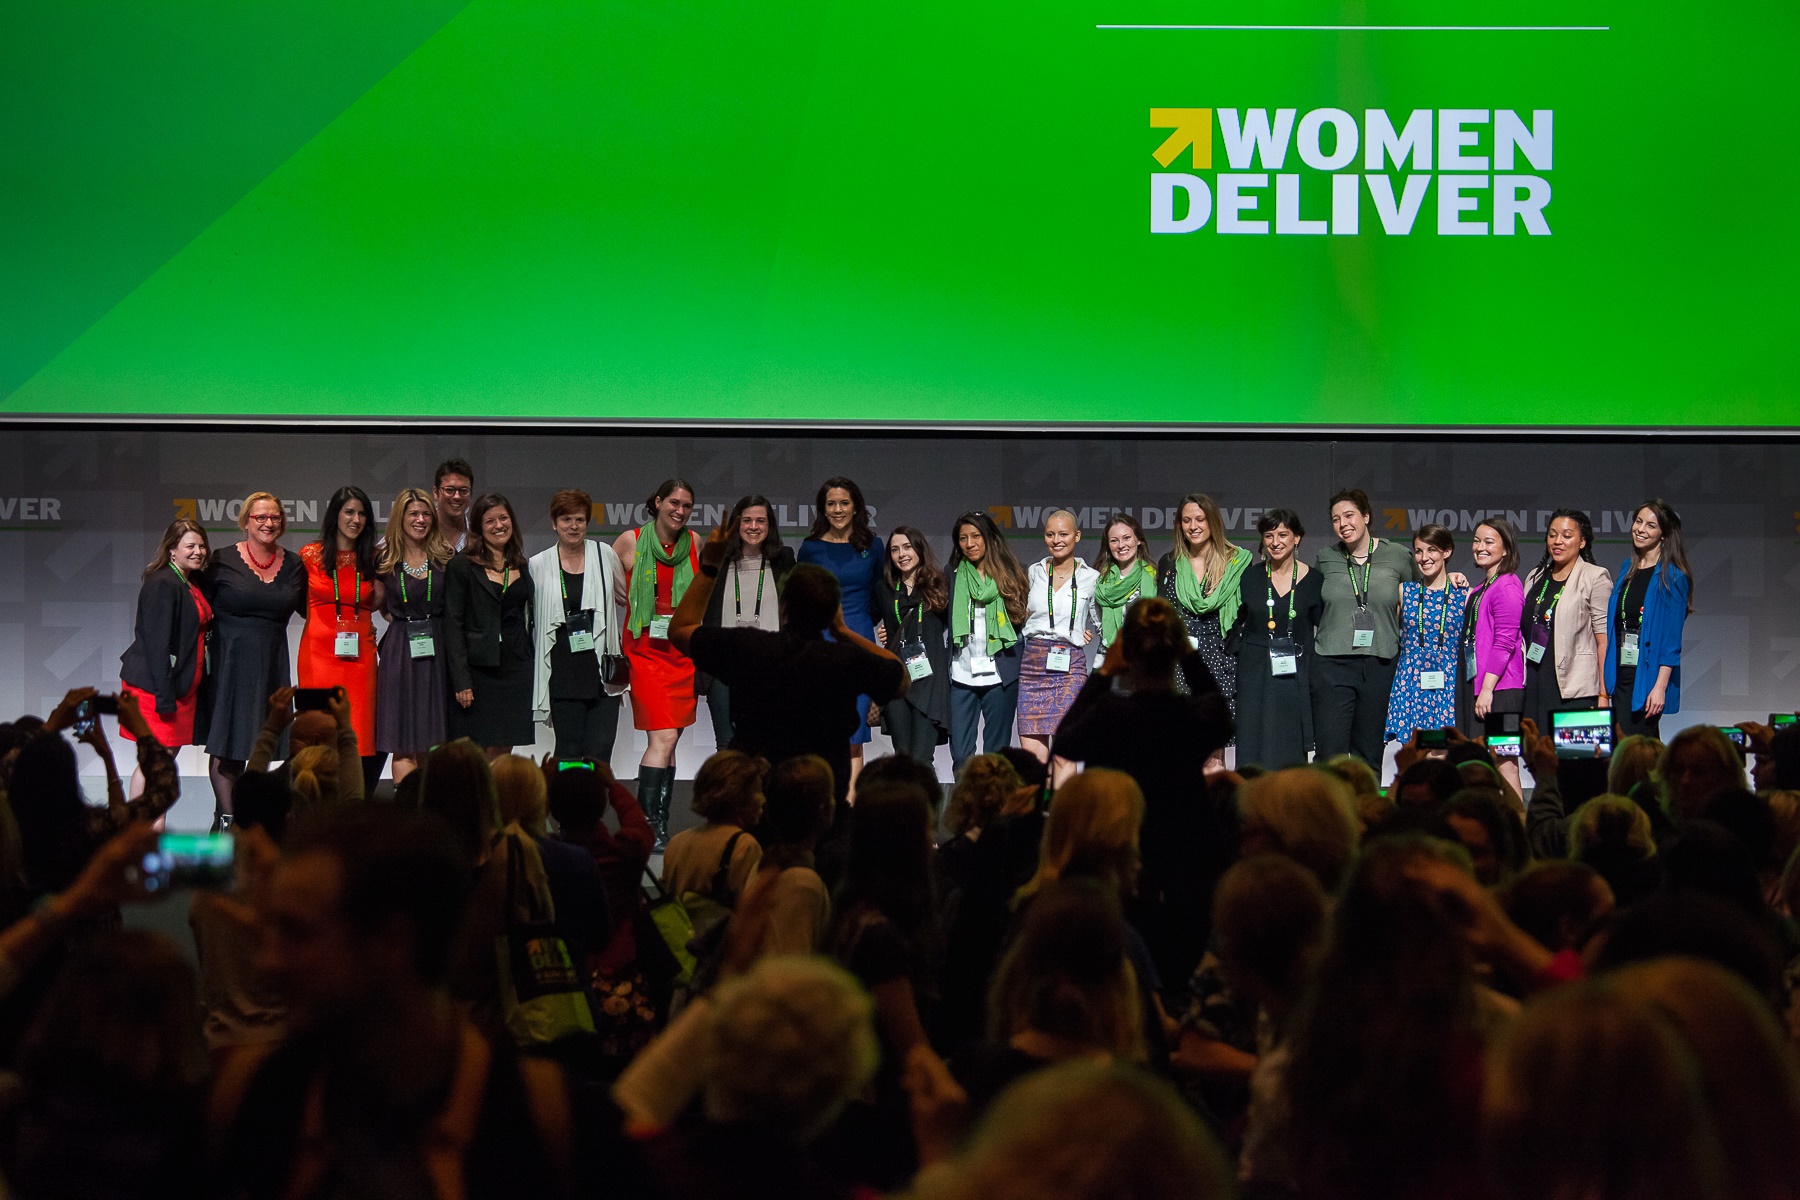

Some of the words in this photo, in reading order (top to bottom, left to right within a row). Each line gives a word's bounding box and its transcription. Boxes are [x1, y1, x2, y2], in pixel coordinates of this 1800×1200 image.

[1217, 107, 1553, 171] WOMEN
[1150, 173, 1552, 235] DELIVER
[198, 499, 317, 522] WOEN
[605, 503, 725, 525] WOEN
